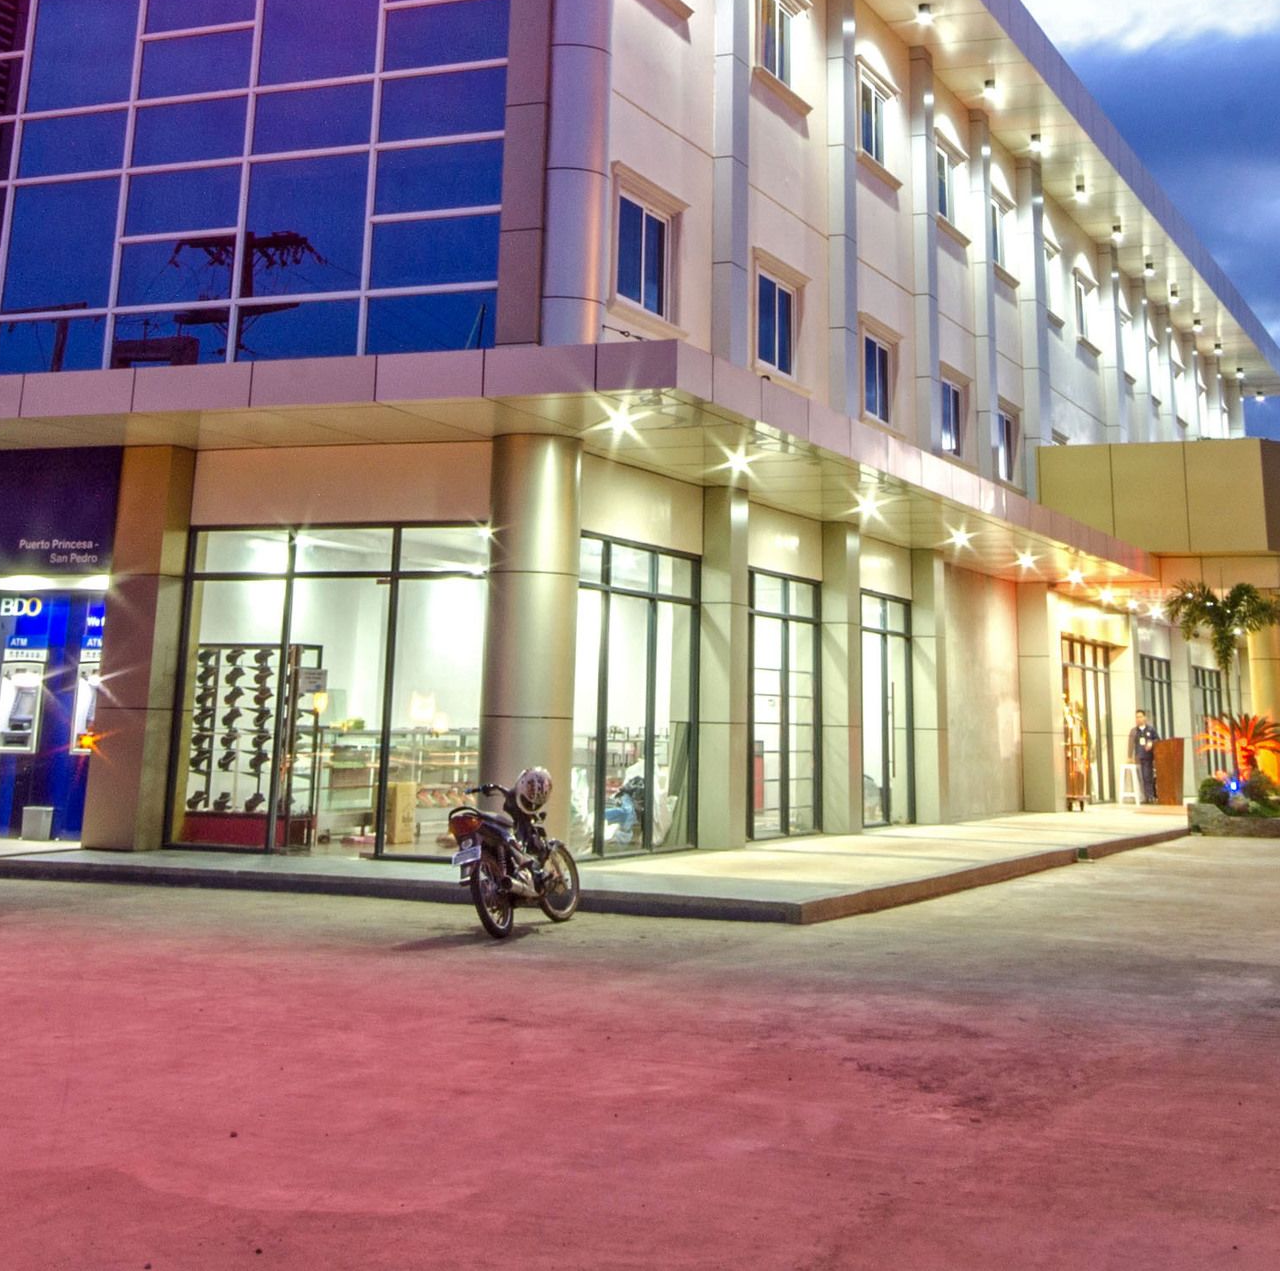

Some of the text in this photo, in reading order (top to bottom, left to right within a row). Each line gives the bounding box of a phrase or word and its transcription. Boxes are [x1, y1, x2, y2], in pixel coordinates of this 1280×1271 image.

[19, 539, 50, 549] Puerto
[52, 539, 93, 549] Princesa
[49, 553, 97, 563] San Pedro
[0, 598, 42, 616] BDO
[10, 638, 28, 647] ATM
